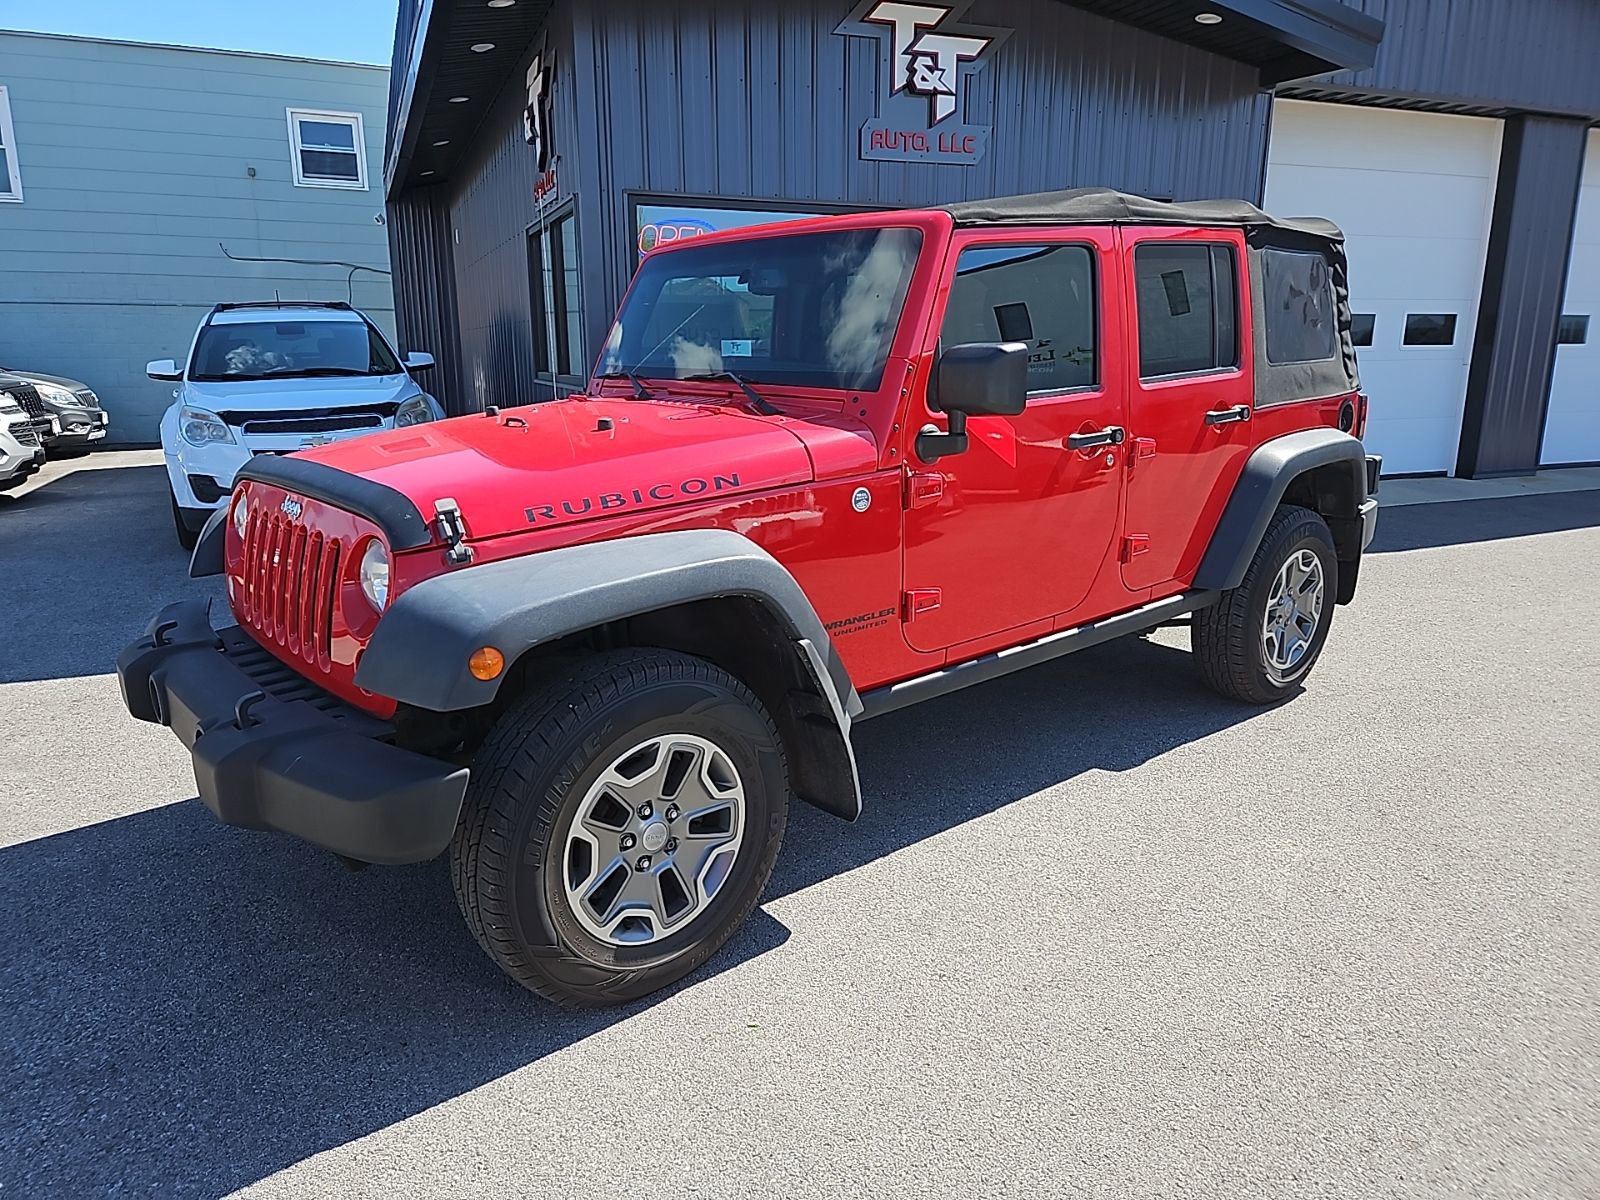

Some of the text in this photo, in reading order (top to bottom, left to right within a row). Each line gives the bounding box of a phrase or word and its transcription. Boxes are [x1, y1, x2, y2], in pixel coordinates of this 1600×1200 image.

[938, 131, 976, 154] LLC
[638, 224, 703, 254] OPE
[523, 473, 742, 523] RUBICON
[823, 607, 897, 631] WRANGLER
[833, 619, 888, 637] UNLIMITED
